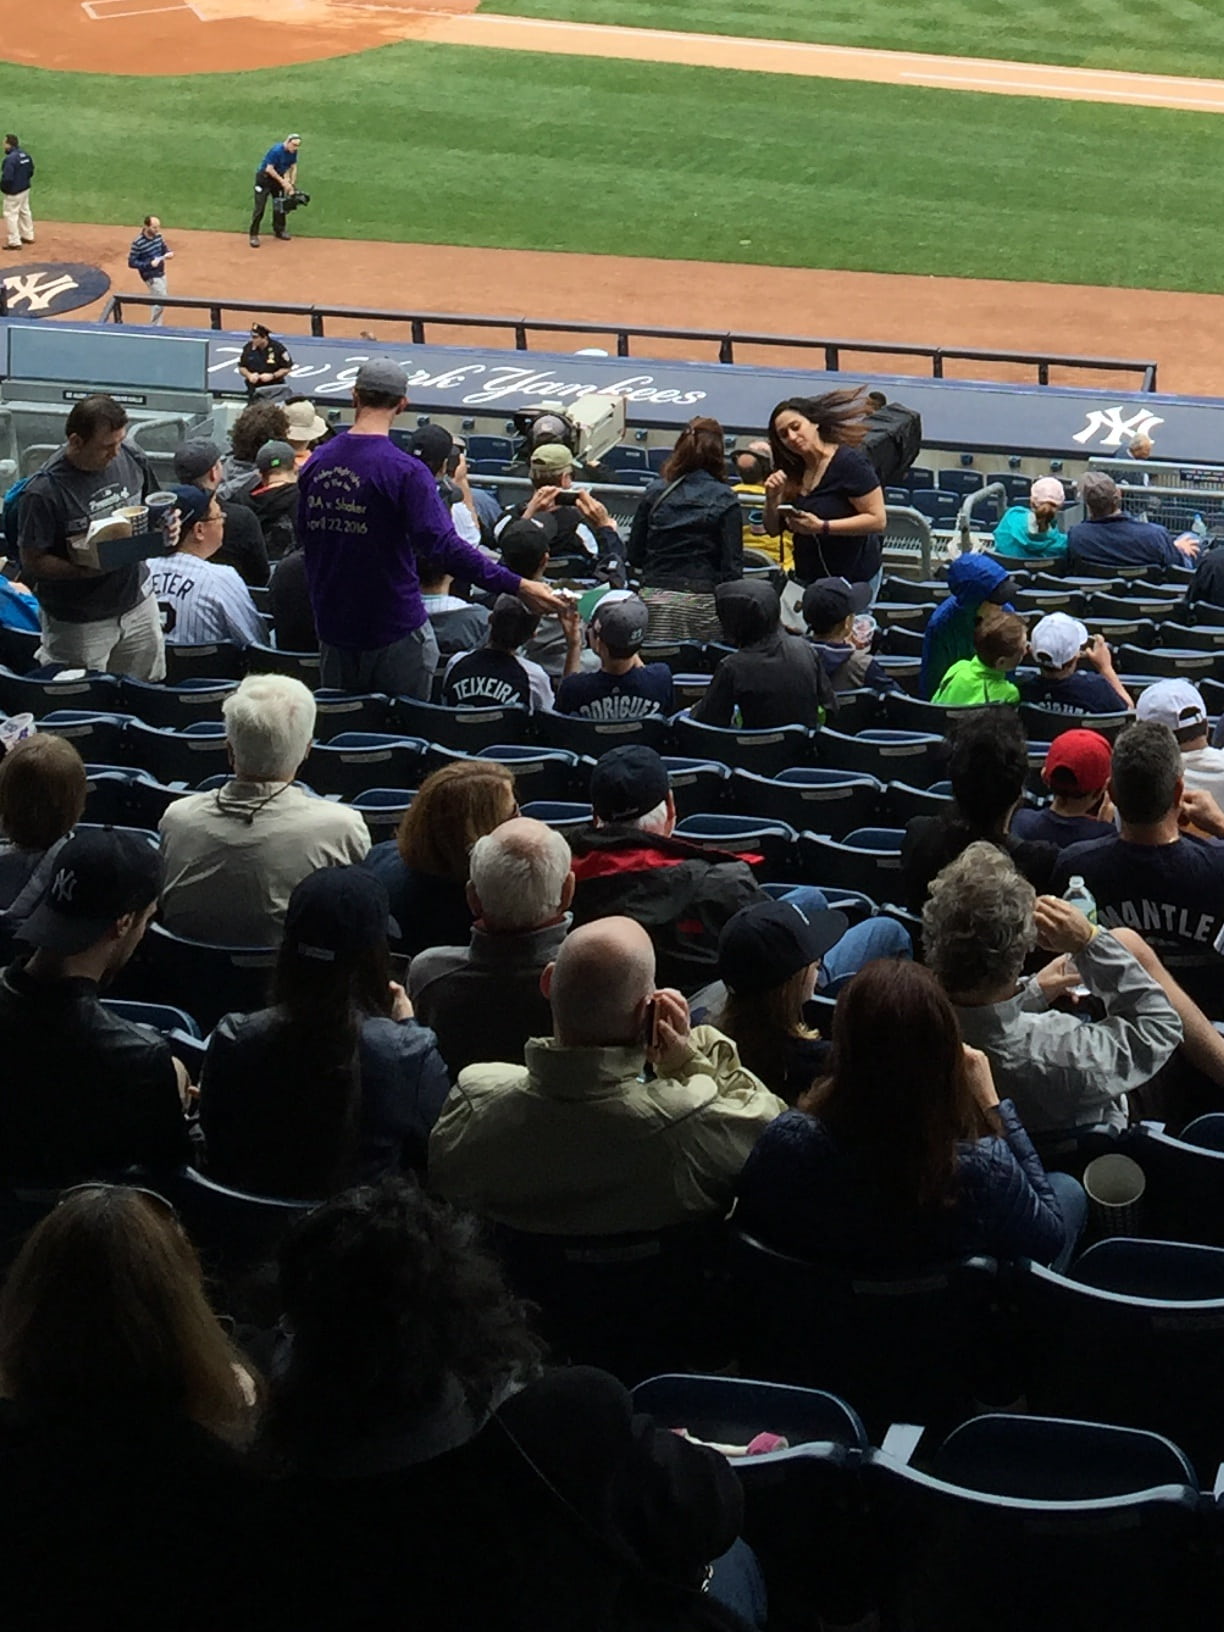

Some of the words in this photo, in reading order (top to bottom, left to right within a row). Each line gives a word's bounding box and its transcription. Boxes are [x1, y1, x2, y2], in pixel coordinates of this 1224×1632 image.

[462, 365, 707, 405] Yankees
[343, 519, 369, 535] 2016
[151, 572, 195, 600] ETER
[452, 675, 522, 706] TEIXEIRA
[1098, 899, 1216, 943] MANTLE
